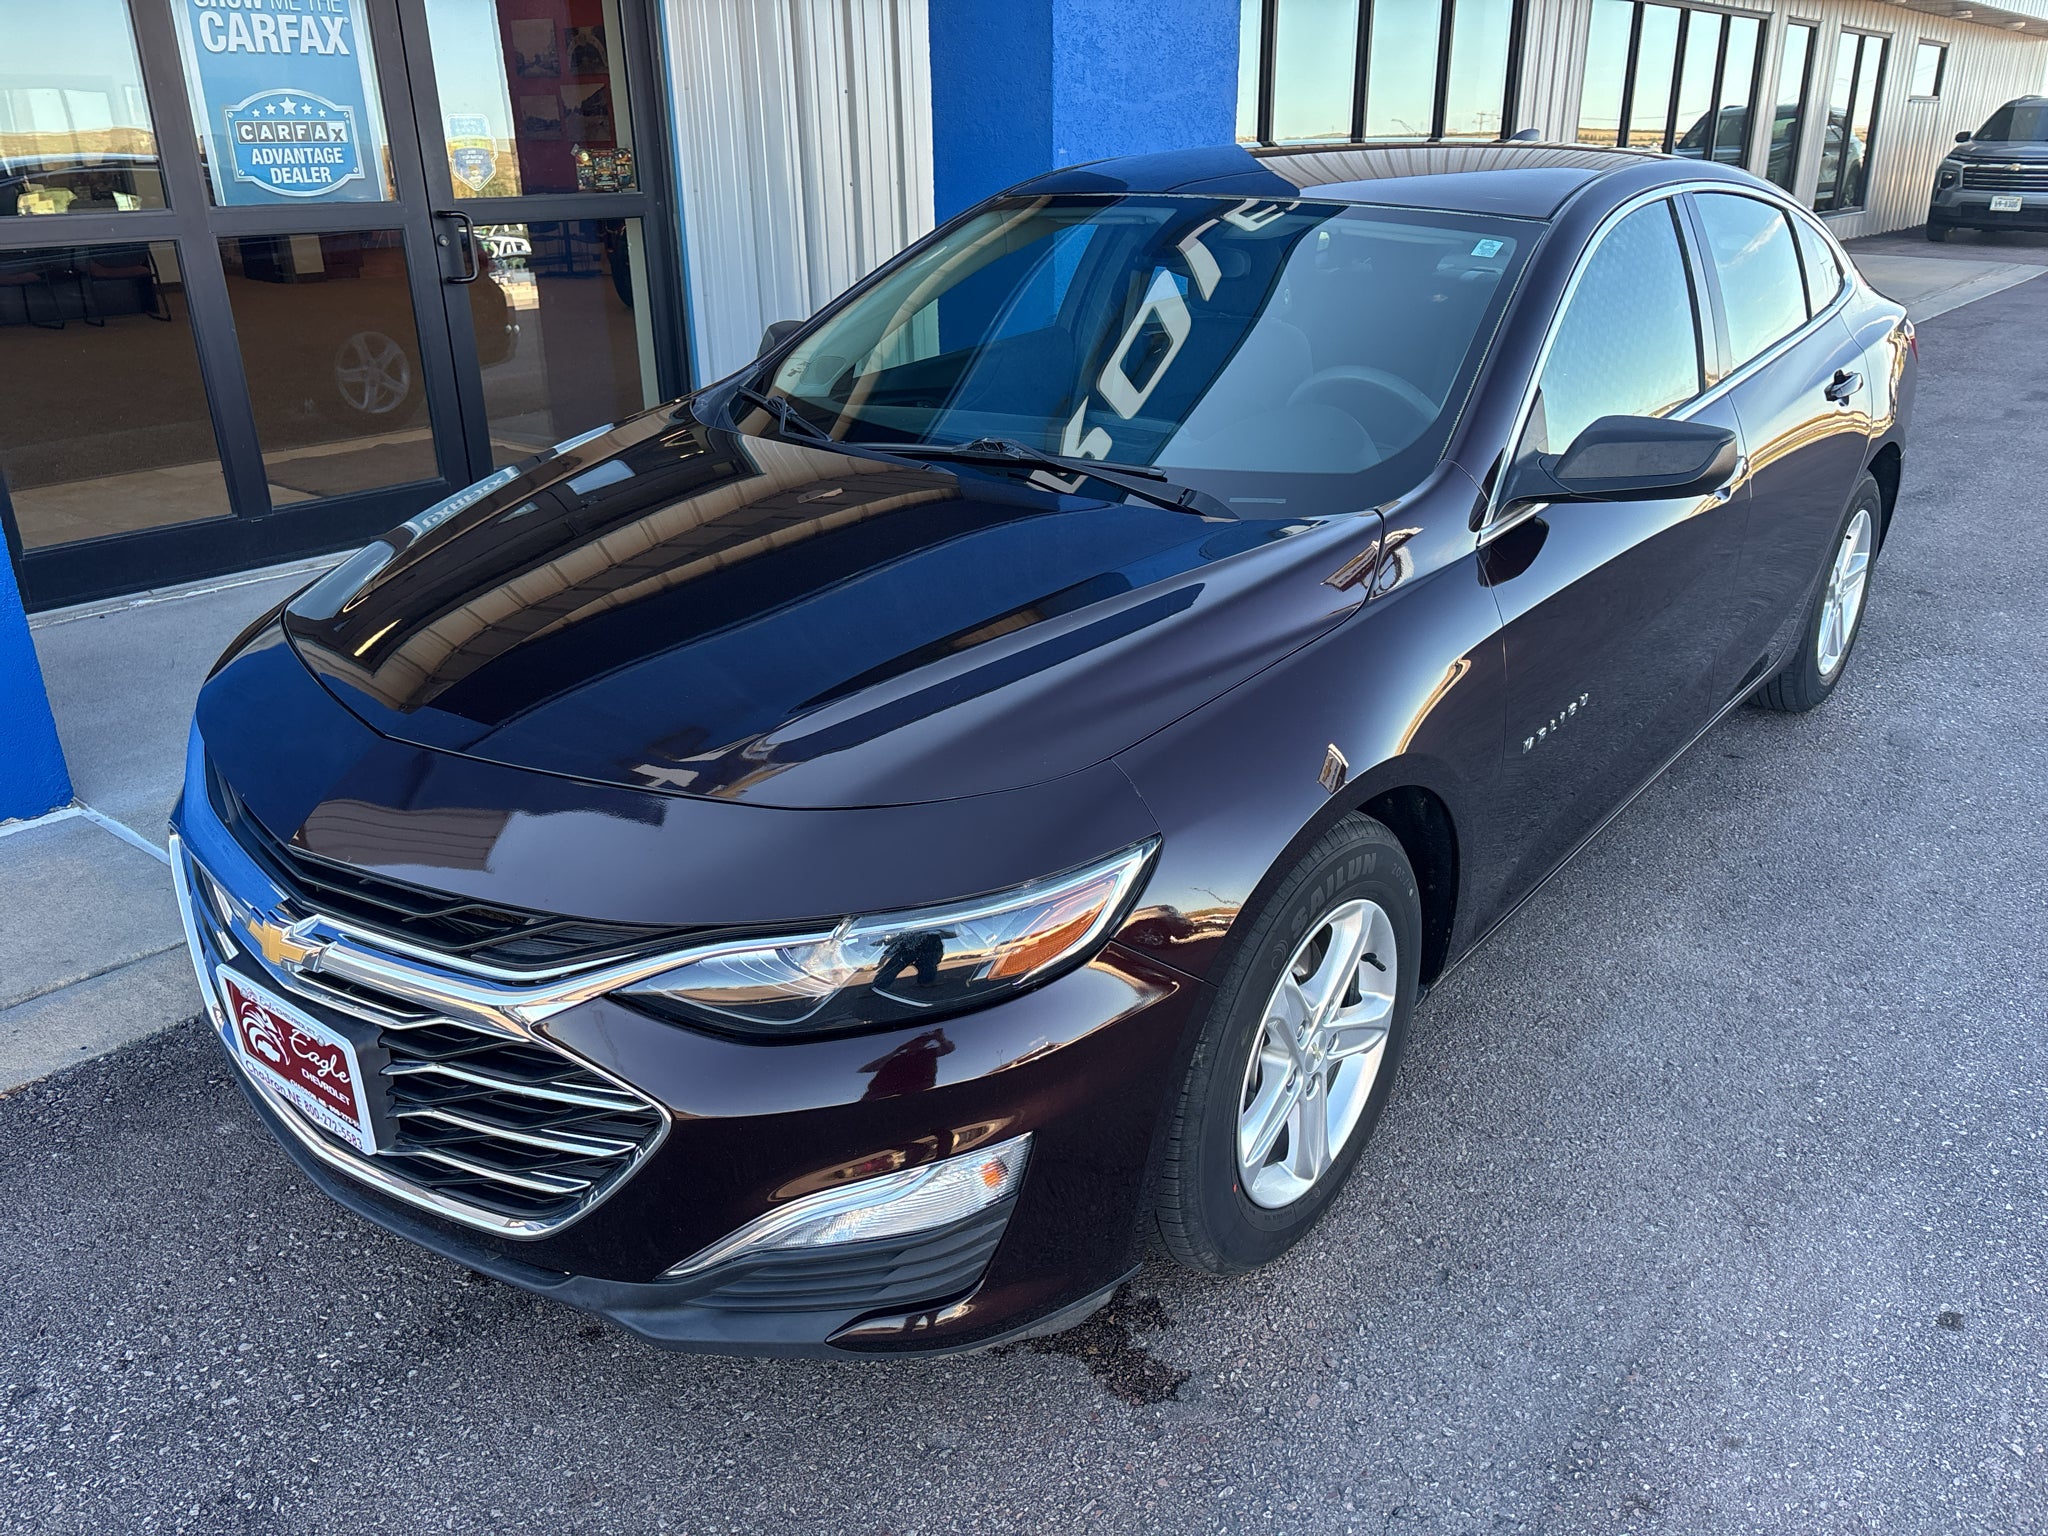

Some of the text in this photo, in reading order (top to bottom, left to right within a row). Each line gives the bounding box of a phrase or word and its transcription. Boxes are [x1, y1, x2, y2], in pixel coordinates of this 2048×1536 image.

[199, 11, 350, 55] CARFAX
[239, 124, 344, 142] CARFAX
[251, 147, 344, 165] ADVANTAGE
[270, 167, 333, 184] DEALER
[1291, 852, 1377, 940] SAILUN
[288, 1028, 351, 1083] Eagle
[301, 1067, 351, 1106] CHEVROLET
[304, 1099, 364, 1150] 800-272-5583
